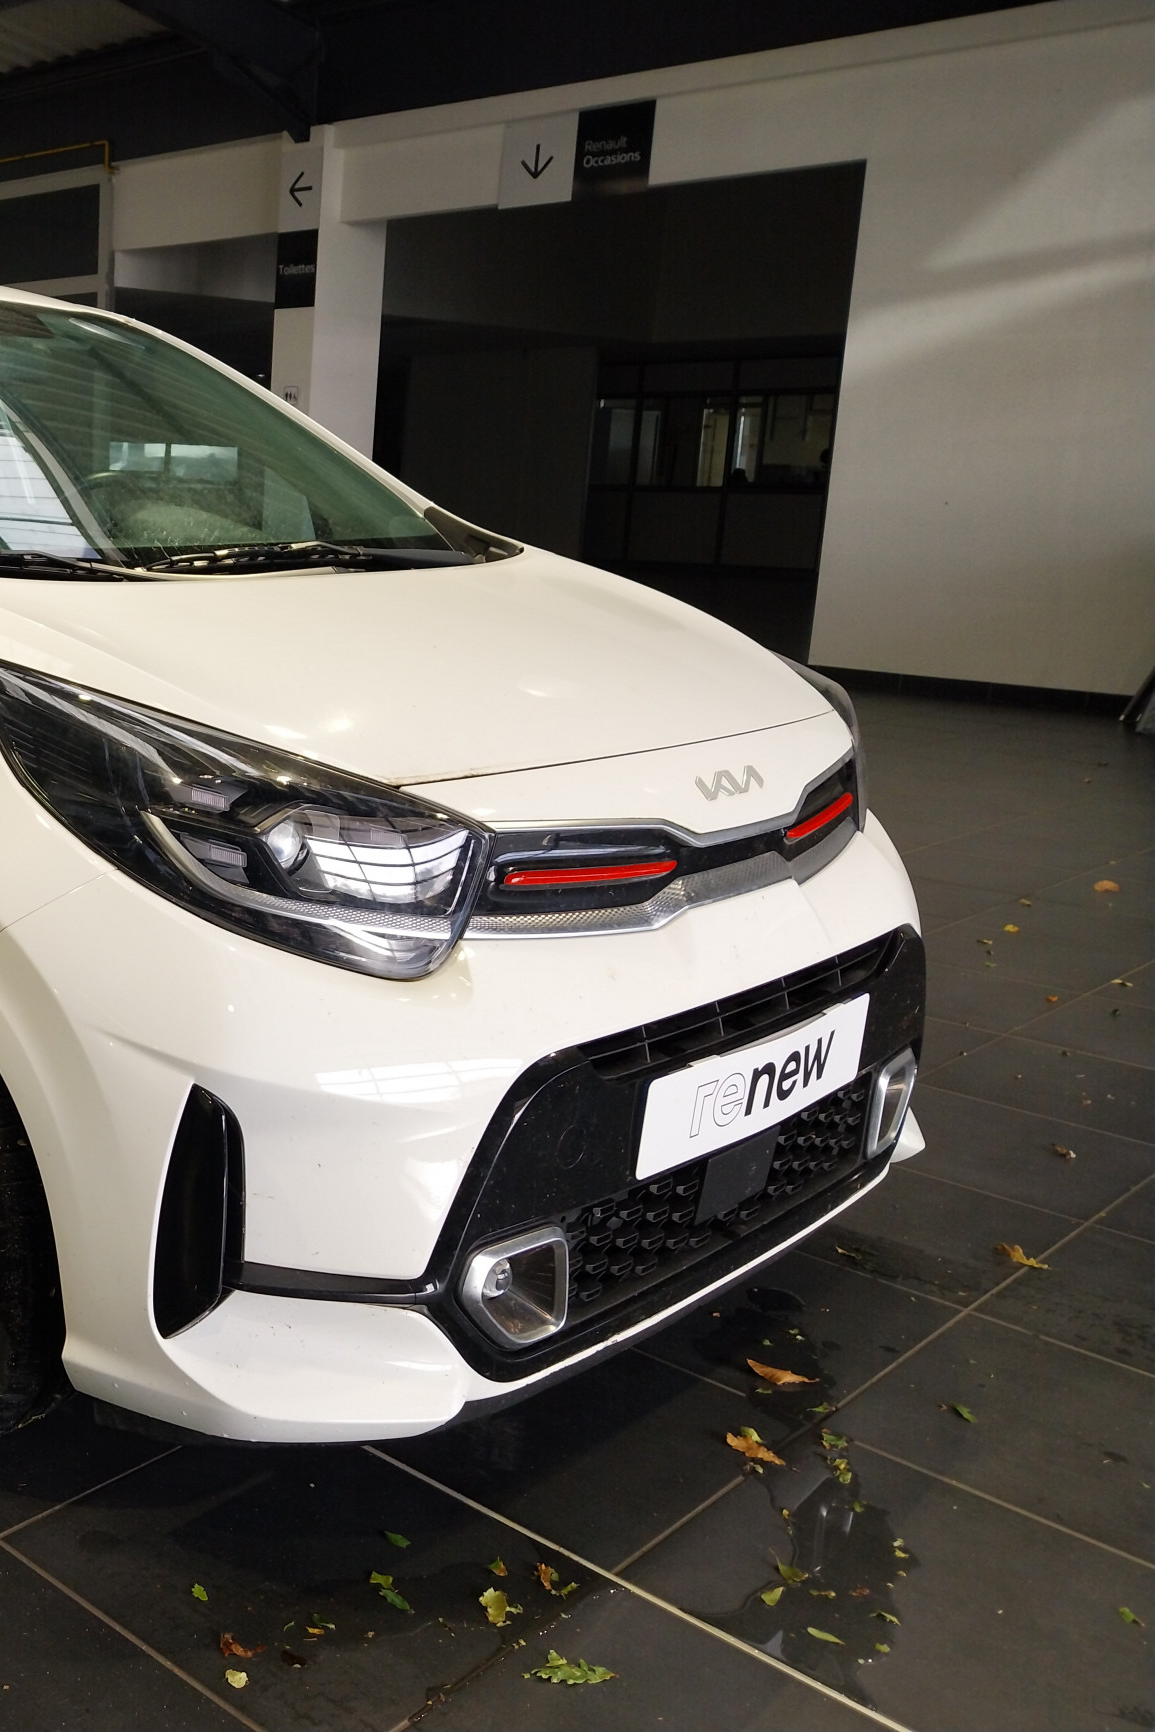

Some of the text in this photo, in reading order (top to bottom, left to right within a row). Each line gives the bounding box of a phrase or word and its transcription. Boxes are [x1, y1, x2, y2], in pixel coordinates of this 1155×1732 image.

[585, 136, 627, 152] Renault
[583, 151, 641, 168] Occasions
[695, 765, 764, 801] KIA
[689, 1029, 836, 1138] renew
